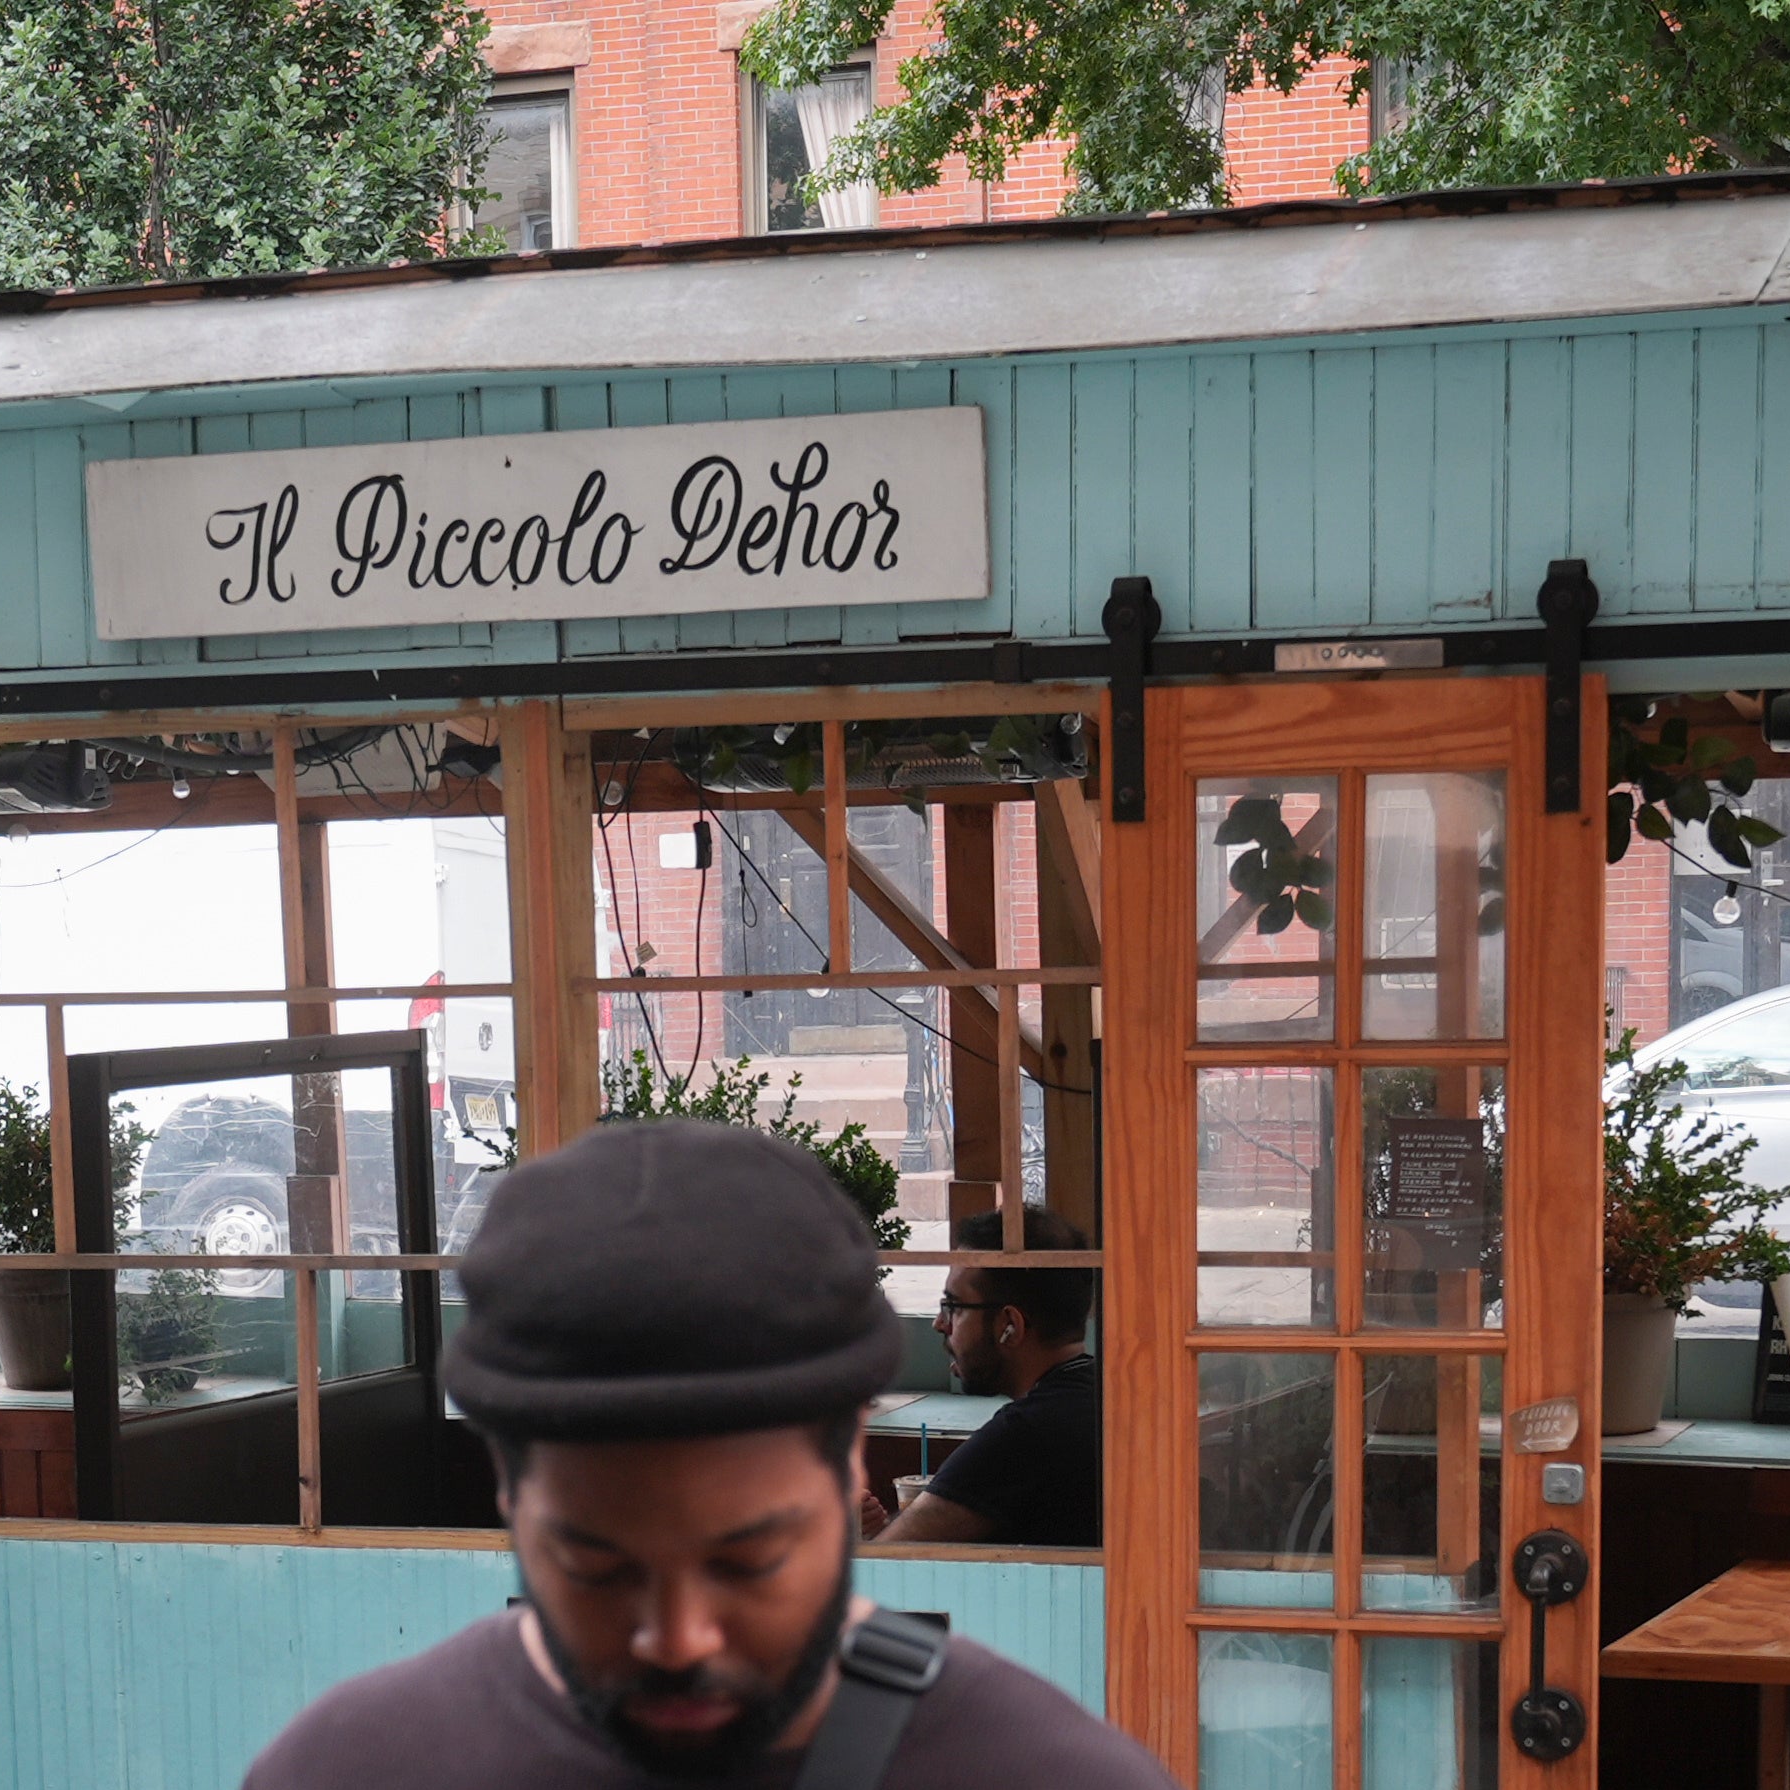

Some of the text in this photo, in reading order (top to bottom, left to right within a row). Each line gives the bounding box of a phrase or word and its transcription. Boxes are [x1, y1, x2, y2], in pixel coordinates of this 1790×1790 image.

[206, 441, 900, 606] Il Piccolo Dehor
[1524, 1420, 1562, 1435] DOOR
